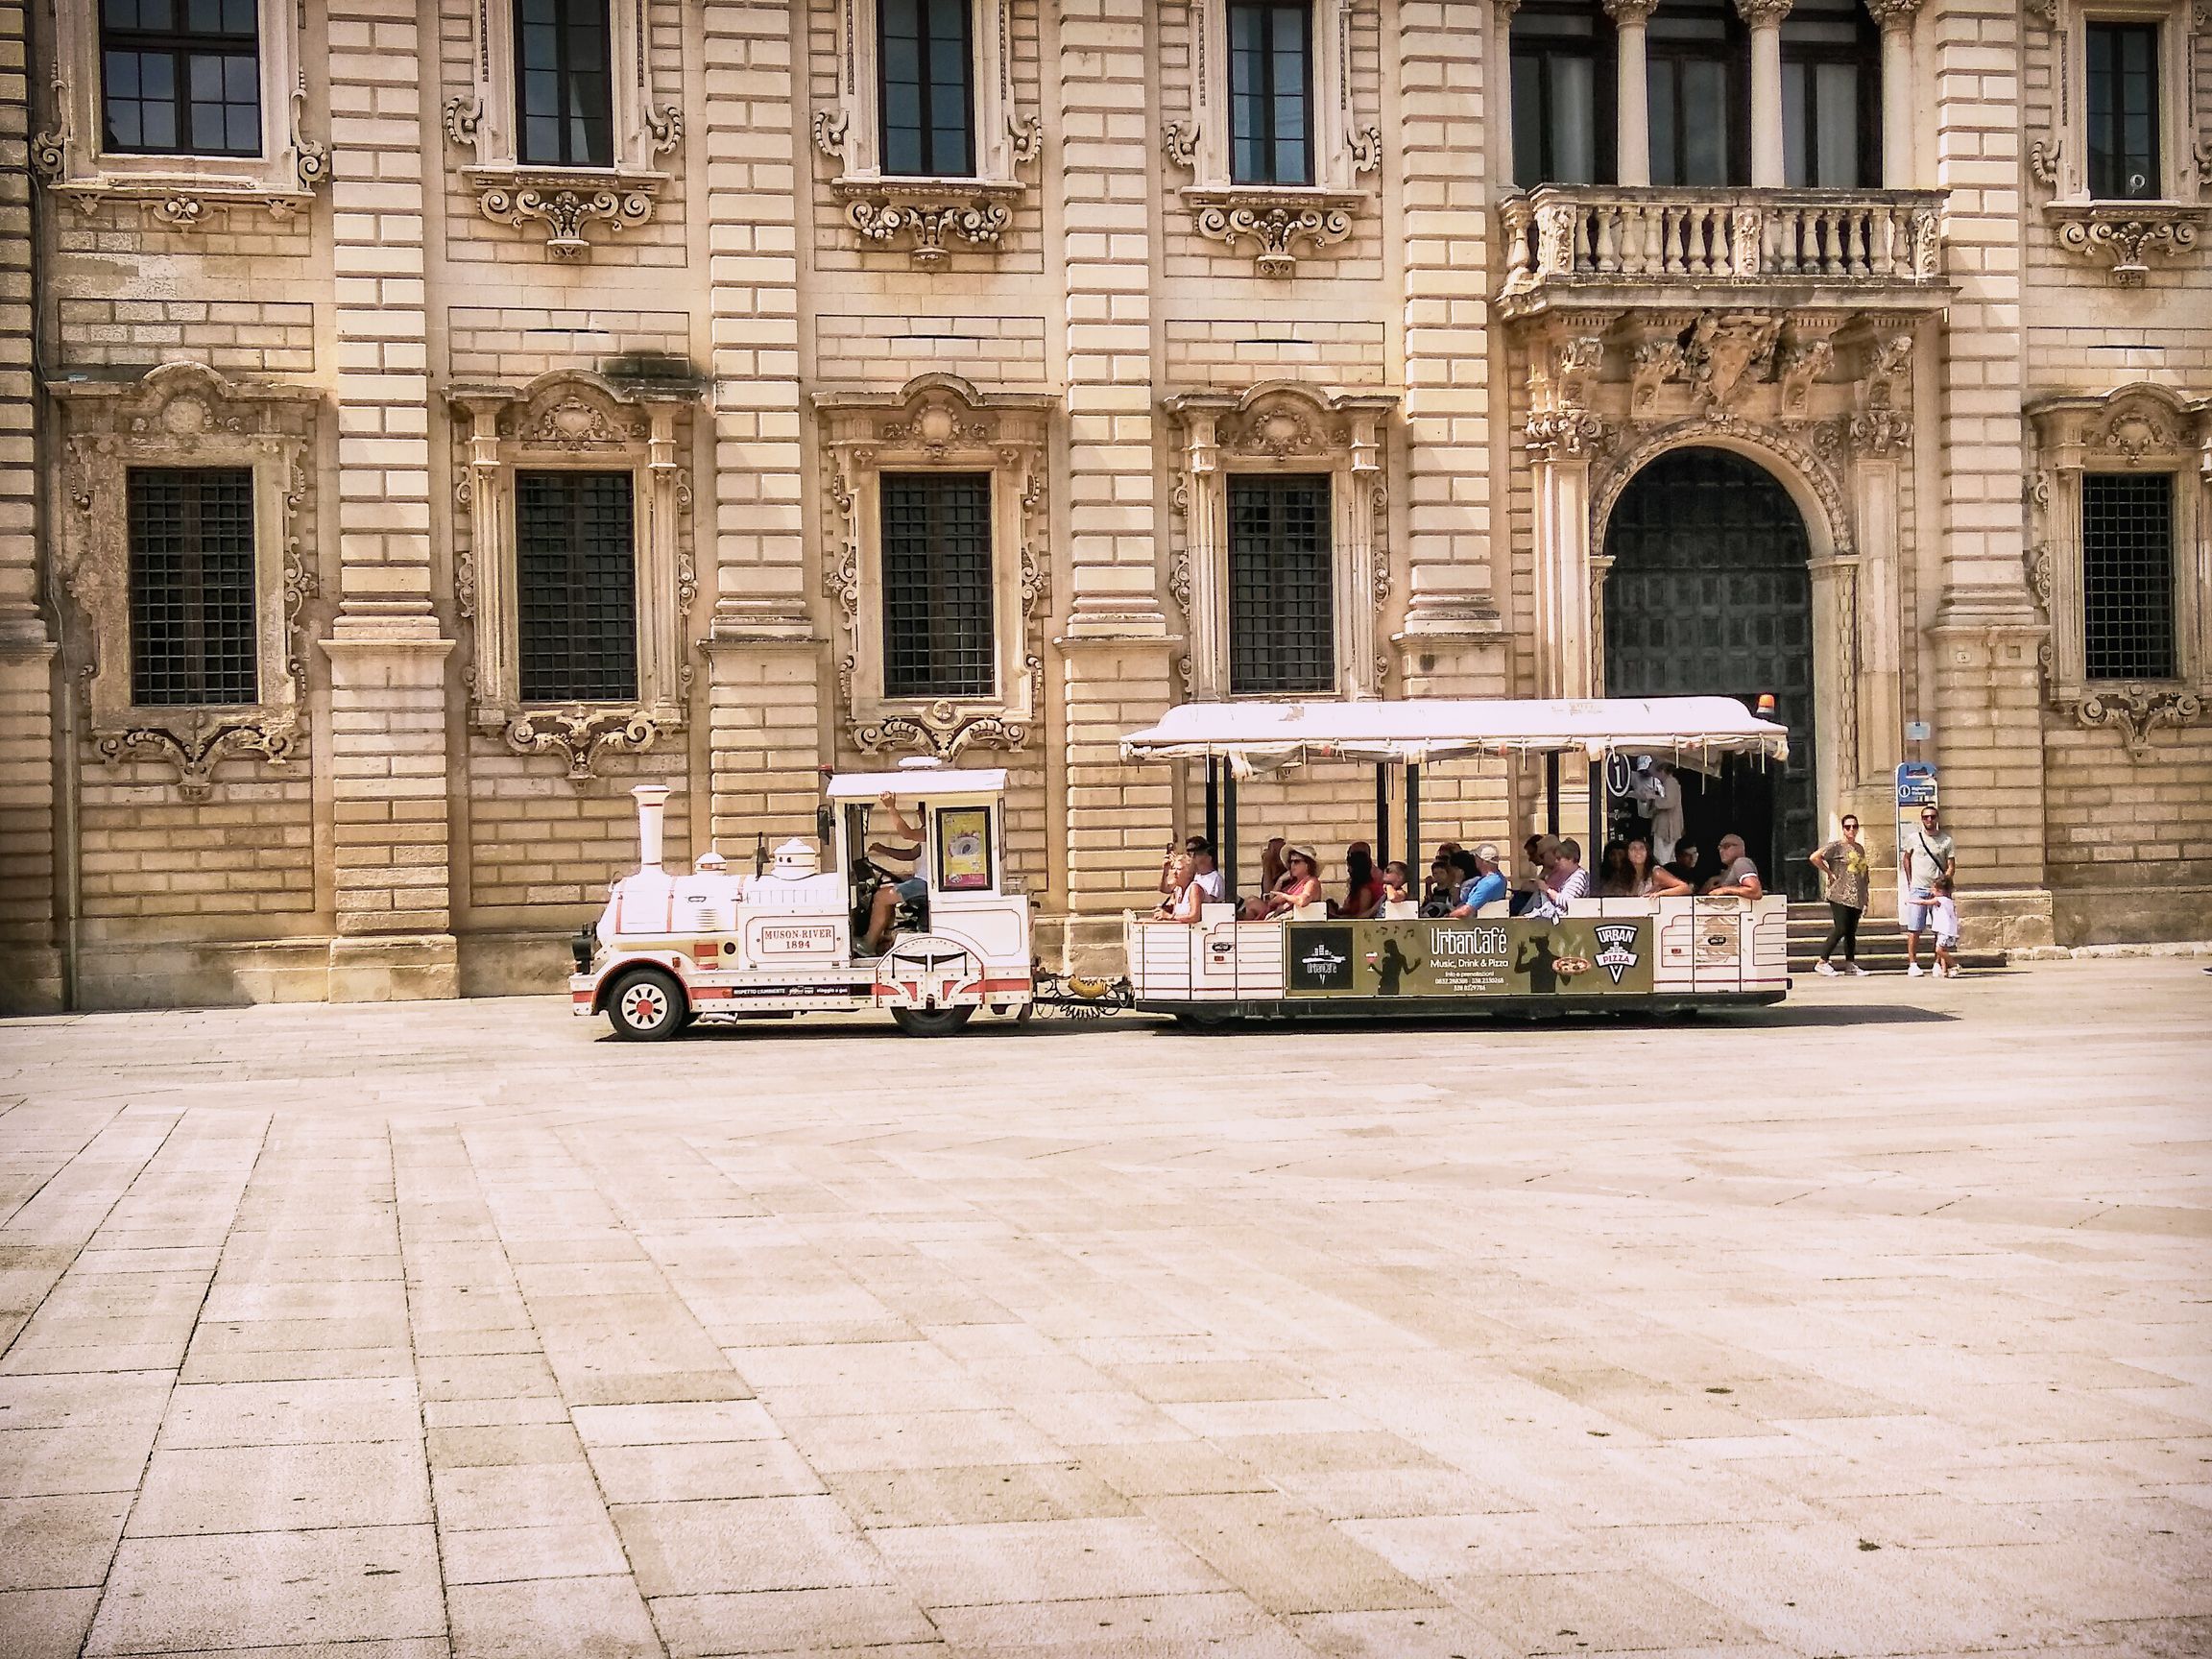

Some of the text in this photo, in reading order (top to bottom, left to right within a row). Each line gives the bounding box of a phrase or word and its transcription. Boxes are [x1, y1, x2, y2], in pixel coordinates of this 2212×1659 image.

[1431, 926, 1507, 955] UrbanCafé
[1597, 929, 1635, 943] URBAN
[785, 940, 811, 950] 1894
[1430, 959, 1457, 969] Music,
[1458, 959, 1479, 968] Drink
[1602, 955, 1630, 964] PIZZA
